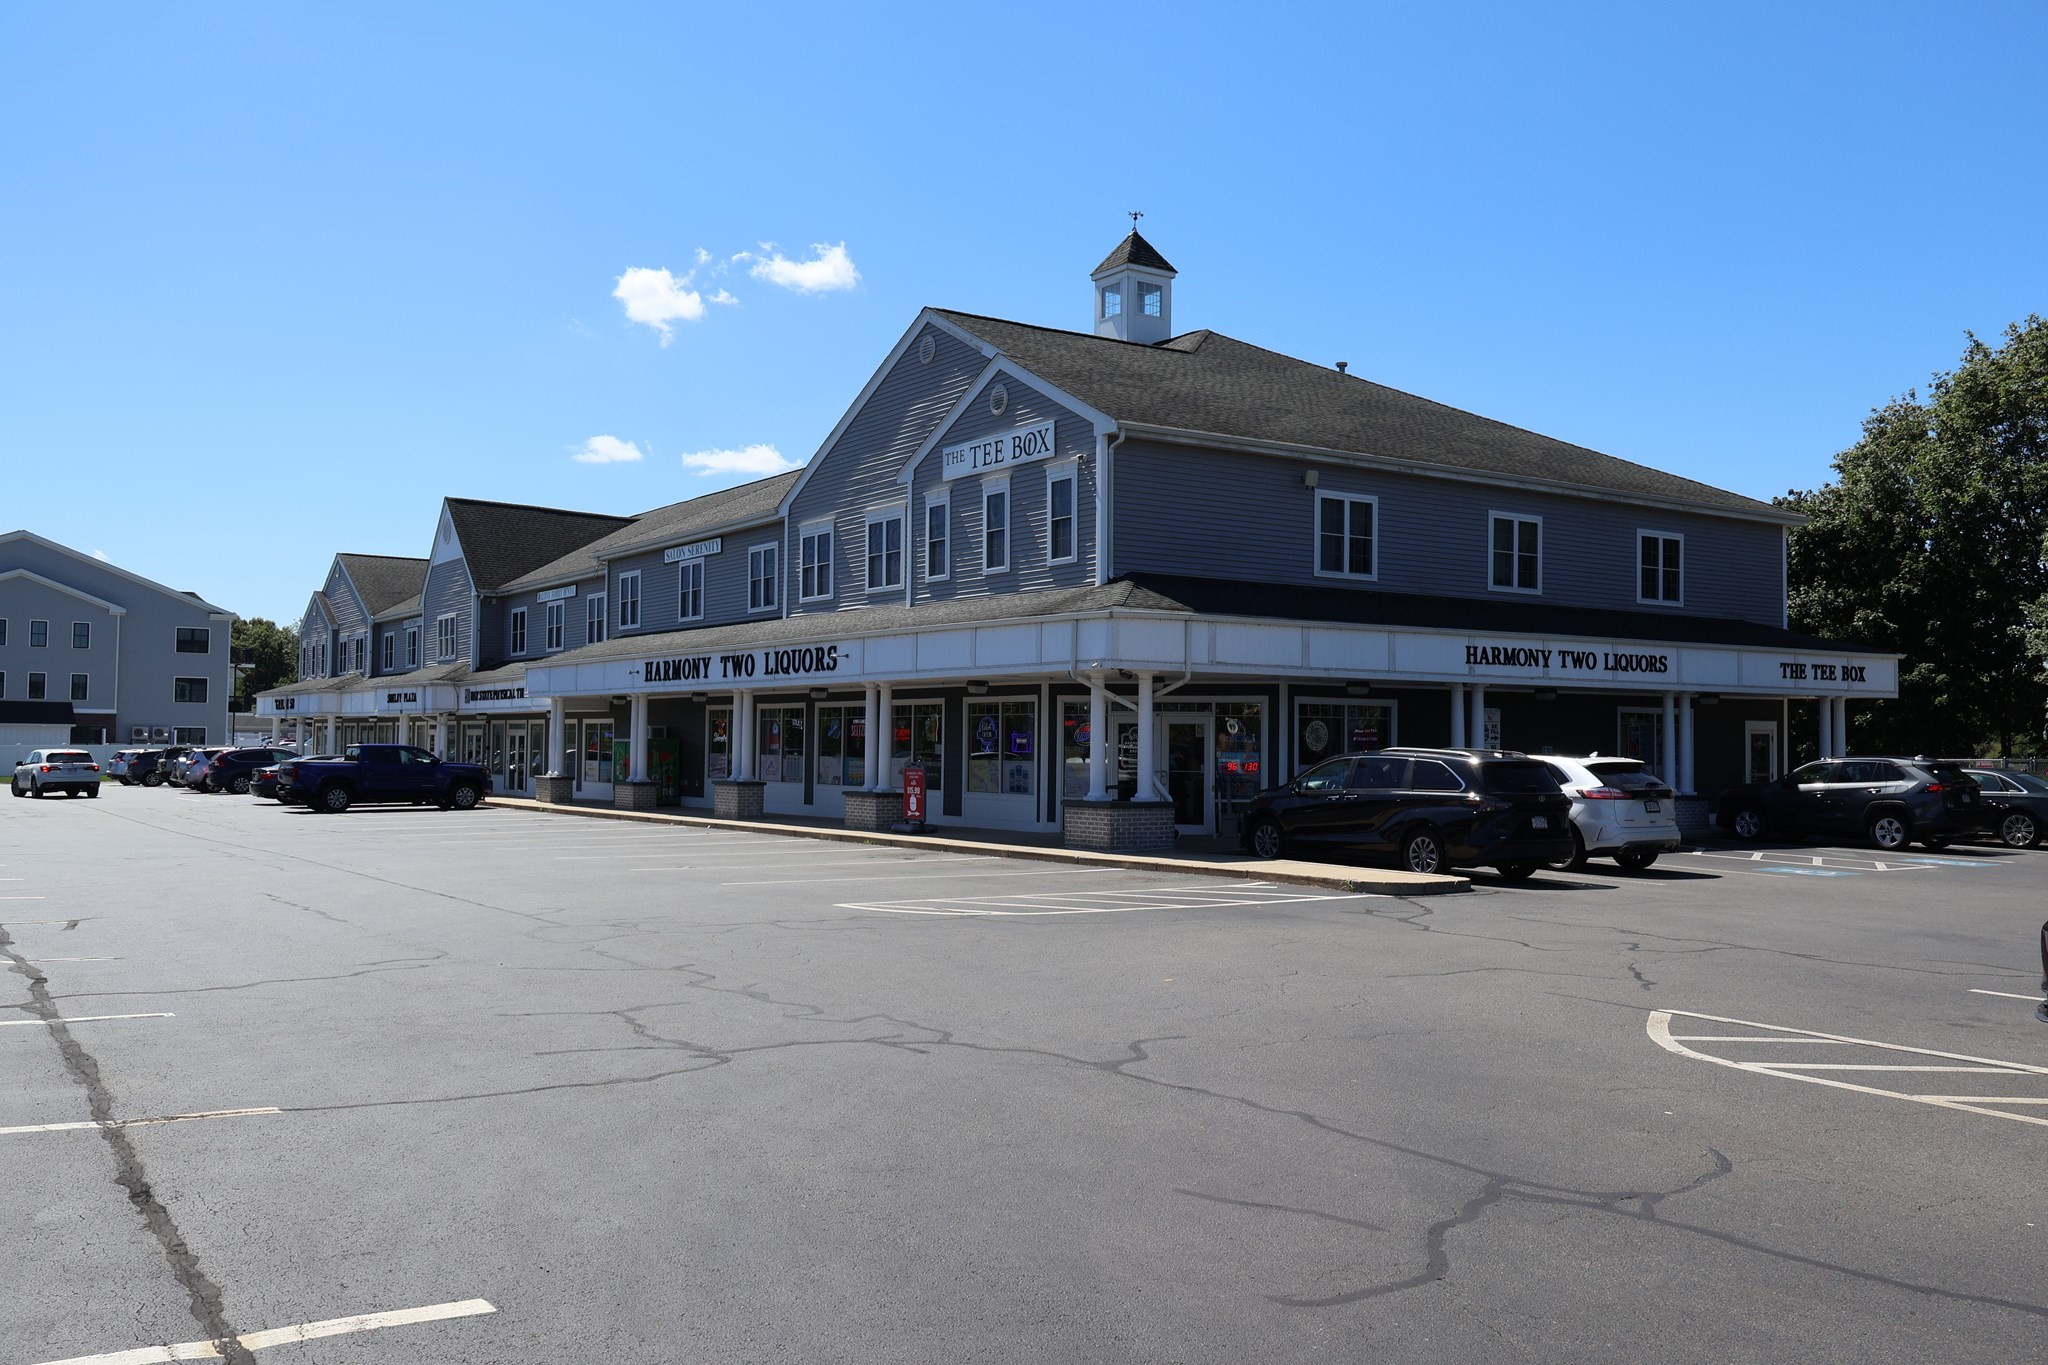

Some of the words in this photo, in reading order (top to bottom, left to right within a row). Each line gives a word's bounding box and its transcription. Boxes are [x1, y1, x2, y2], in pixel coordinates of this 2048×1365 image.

[945, 449, 965, 466] THE
[969, 439, 1005, 469] TEE
[1011, 427, 1050, 460] BOX
[665, 546, 686, 561] SALON
[687, 540, 720, 556] SERENITY
[644, 656, 711, 682] HARMONY
[720, 653, 755, 678] TWO
[763, 645, 838, 675] LIQUORS
[1465, 645, 1552, 668] HARMONY
[1558, 650, 1597, 670] TWO
[1603, 652, 1668, 673] LIQUORS
[1780, 662, 1807, 679] THE
[1811, 664, 1837, 681] TEE
[1841, 665, 1866, 682] BOX
